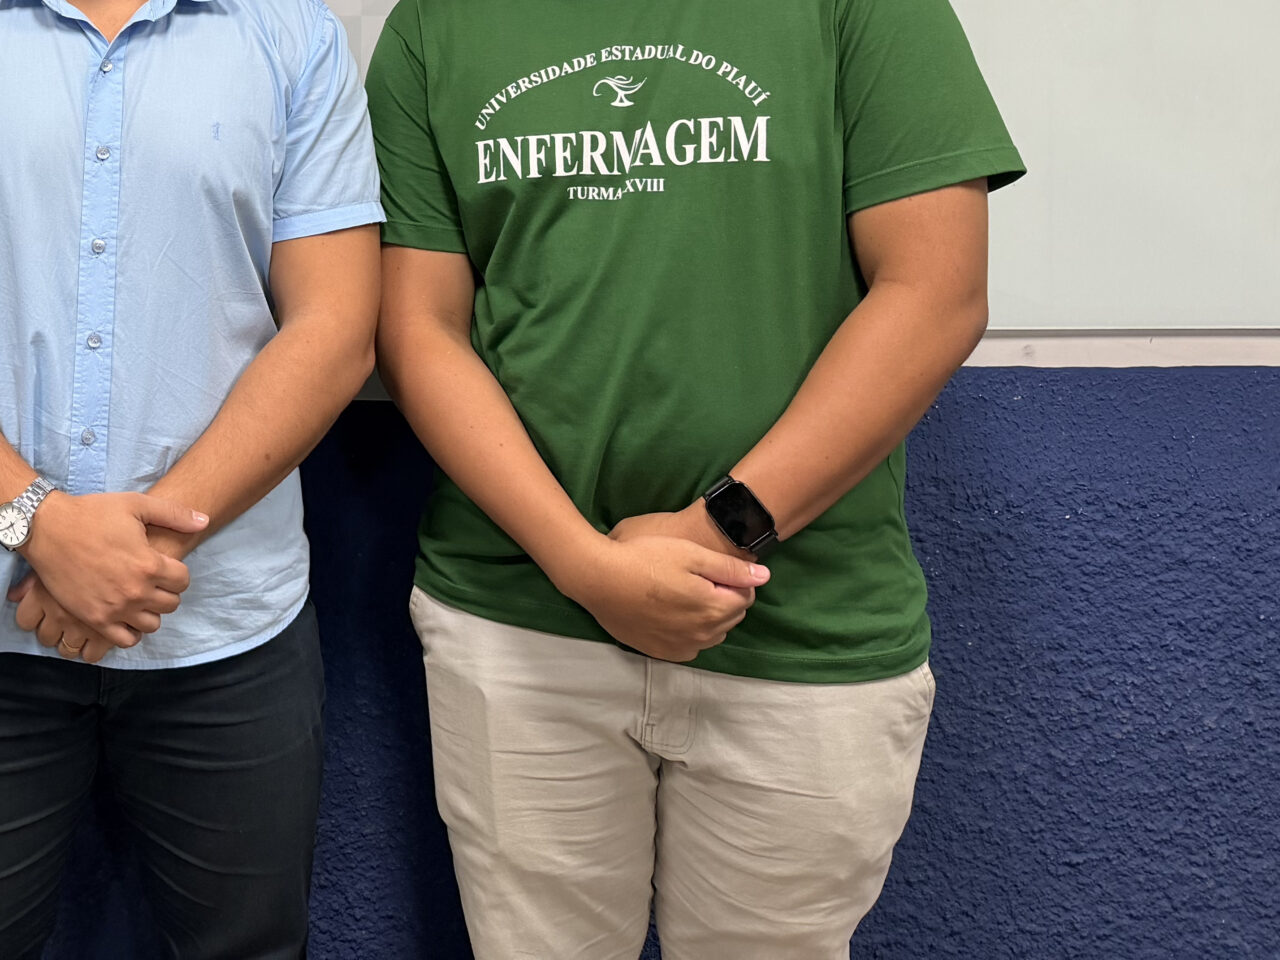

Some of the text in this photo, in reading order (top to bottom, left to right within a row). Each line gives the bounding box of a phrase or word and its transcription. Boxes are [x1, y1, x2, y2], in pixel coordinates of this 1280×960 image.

[474, 44, 771, 131] UNIVERSIDADE ESTADUAL DO PIAUÍ
[474, 115, 771, 184] ENFERMAGEM
[566, 178, 665, 201] TURMA XVIII
